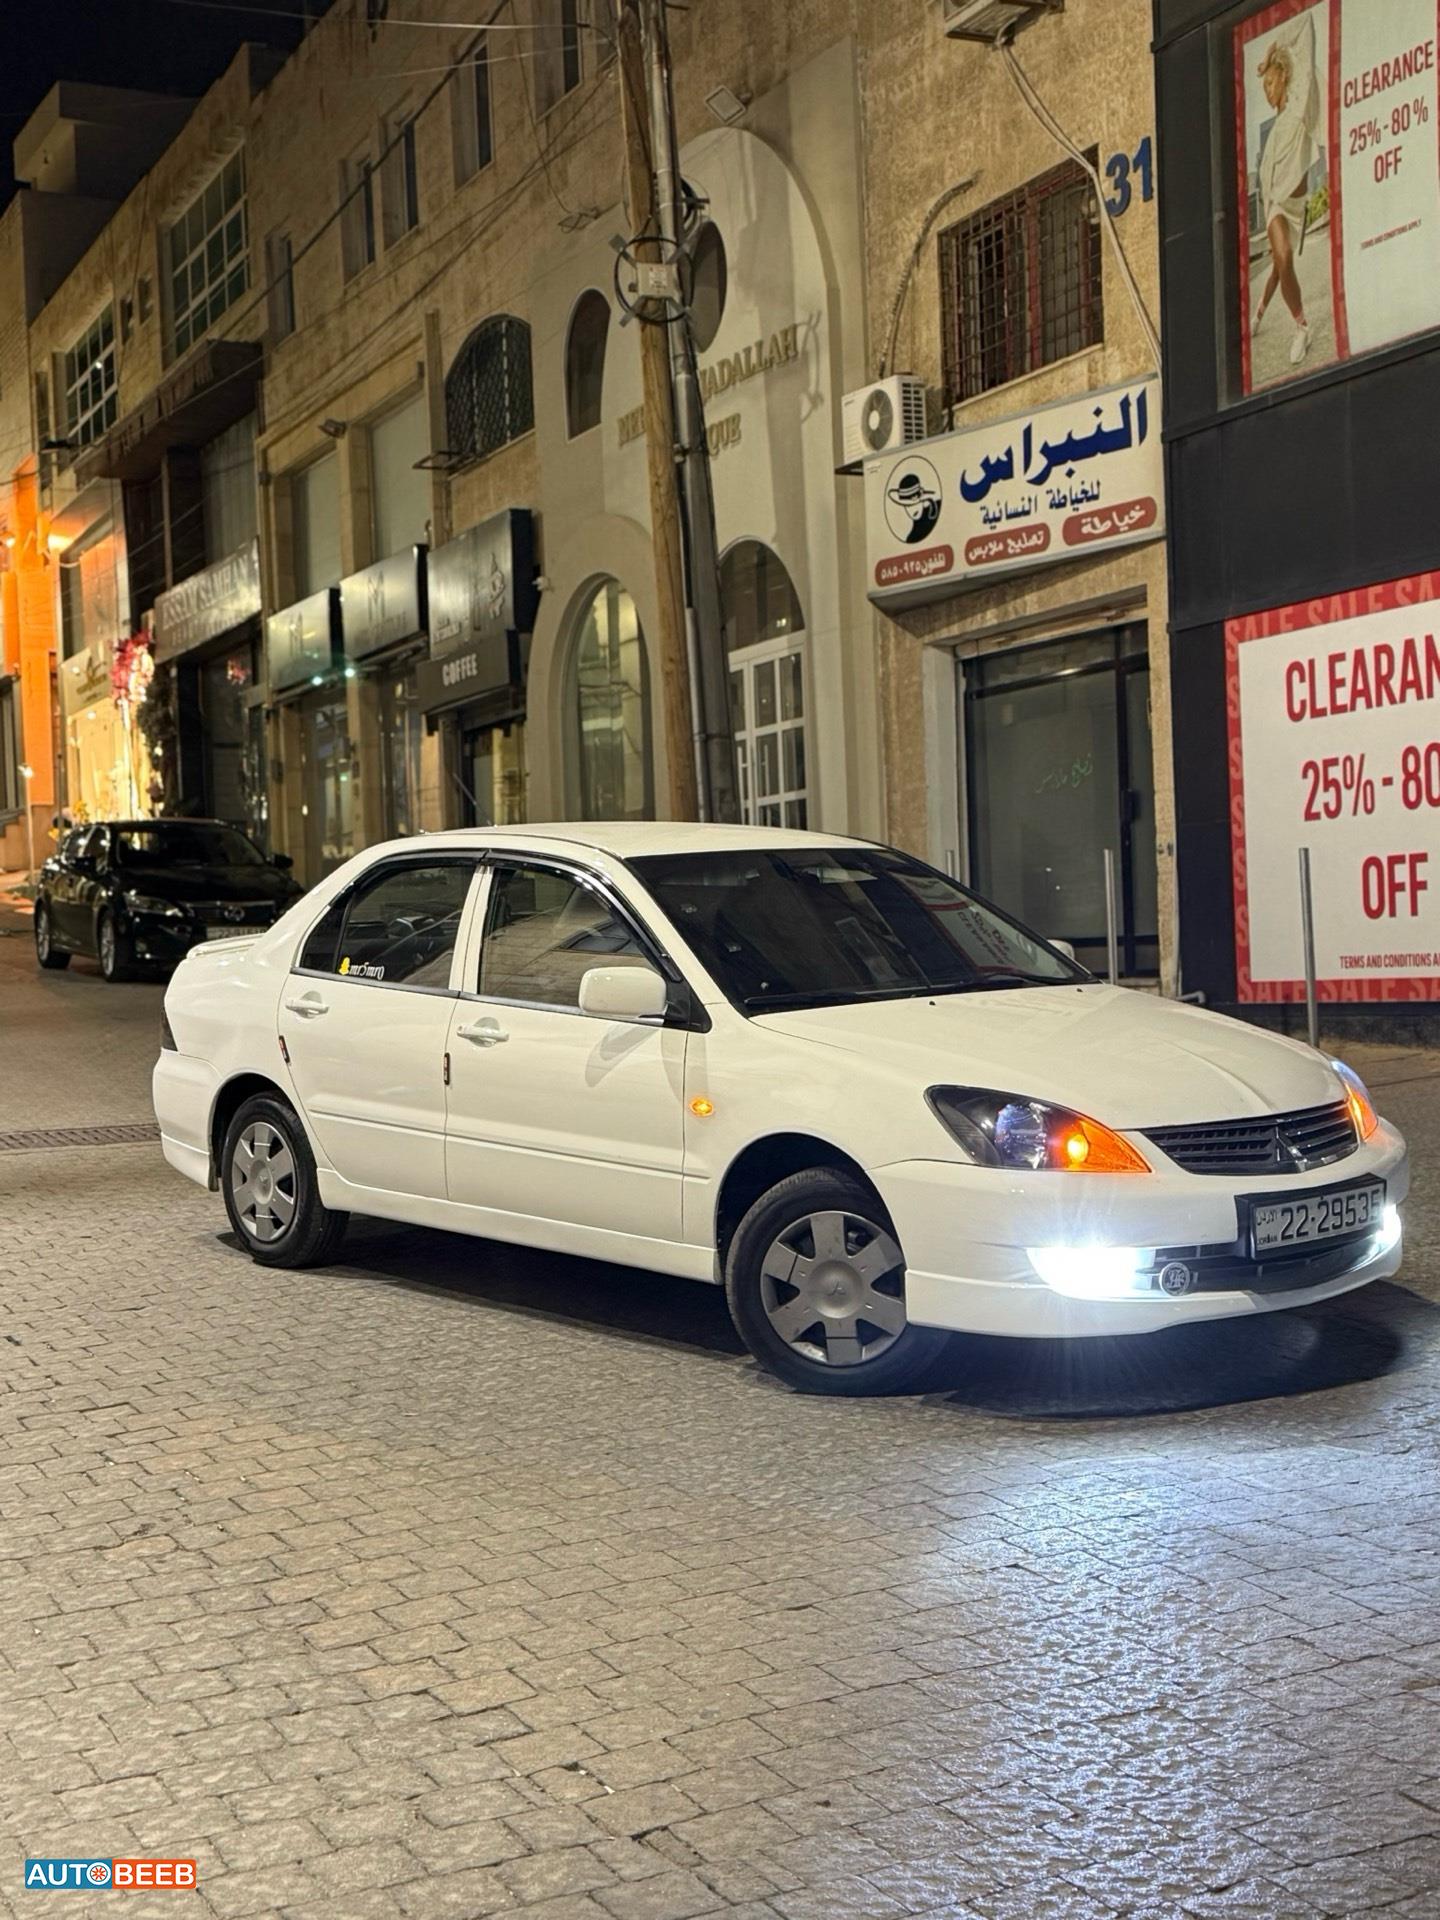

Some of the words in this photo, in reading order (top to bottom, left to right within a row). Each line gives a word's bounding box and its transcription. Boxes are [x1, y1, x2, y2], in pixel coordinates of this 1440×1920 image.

[1343, 40, 1434, 109] CLEARANCE
[1105, 136, 1154, 218] 31
[1374, 146, 1402, 183] OFF
[960, 386, 1148, 503] النبراس
[1046, 480, 1101, 512] للخياطة
[1081, 505, 1146, 534] خياطة
[442, 653, 478, 687] COFFEE
[1302, 753, 1375, 822] 25%
[1362, 852, 1429, 920] OFF
[1339, 955, 1365, 969] TERMS
[1366, 954, 1383, 968] AND
[1383, 953, 1432, 968] CONDITIONS
